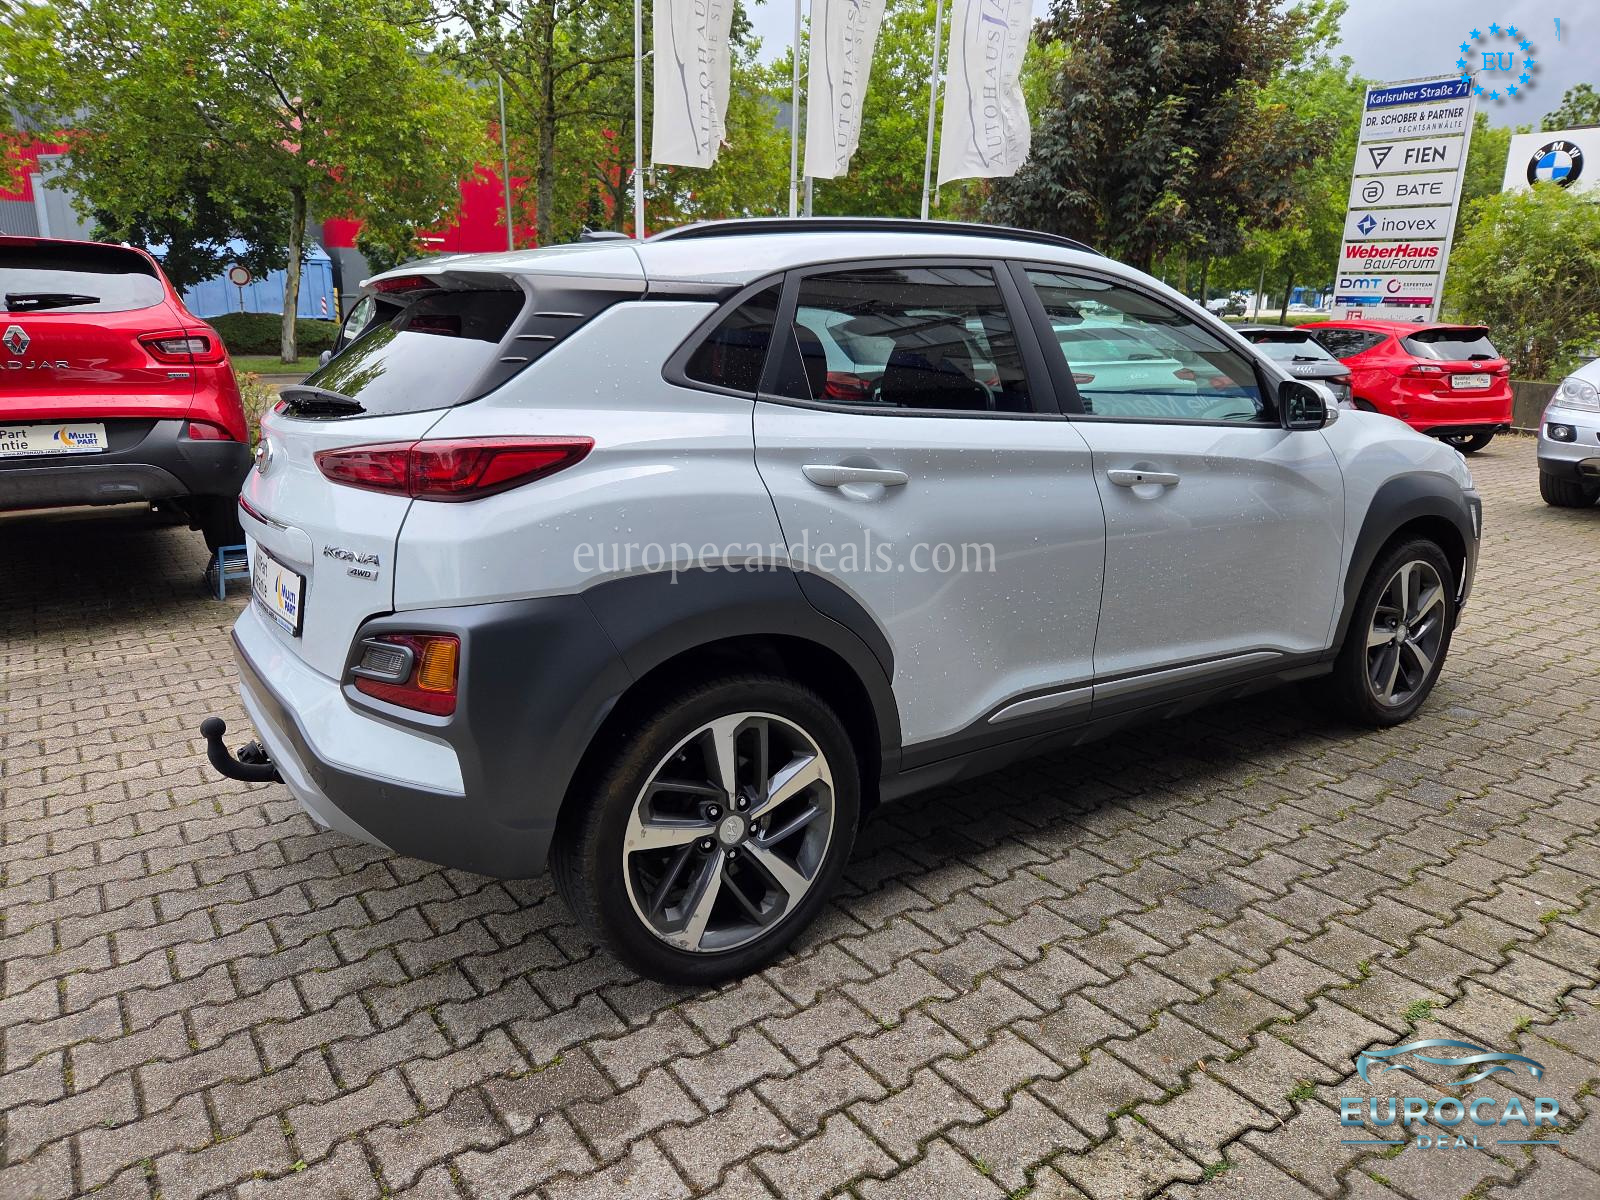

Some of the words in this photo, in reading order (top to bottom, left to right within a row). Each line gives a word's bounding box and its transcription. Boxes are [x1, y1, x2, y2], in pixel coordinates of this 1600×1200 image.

[836, 9, 857, 168] AUTOHAUS
[1369, 90, 1418, 104] Karlsruher
[1420, 85, 1453, 99] Straße
[1455, 82, 1468, 94] 71
[983, 30, 1004, 166] AUTOHAUS
[1366, 116, 1378, 126] DR.
[1380, 112, 1418, 125] SCHOBER
[1419, 111, 1425, 121] &
[1427, 107, 1464, 120] PARTNER
[1398, 120, 1462, 133] RECHTSANWÄLTE
[1404, 145, 1447, 164] FIEN
[1534, 141, 1581, 161] BMW
[1396, 182, 1443, 196] BATE
[1381, 217, 1437, 231] inovex
[1346, 243, 1439, 258] WeberHaus
[1363, 259, 1435, 269] BauForum
[0, 360, 70, 369] DJAR
[323, 544, 380, 567] KONA
[350, 568, 371, 578] 4WD
